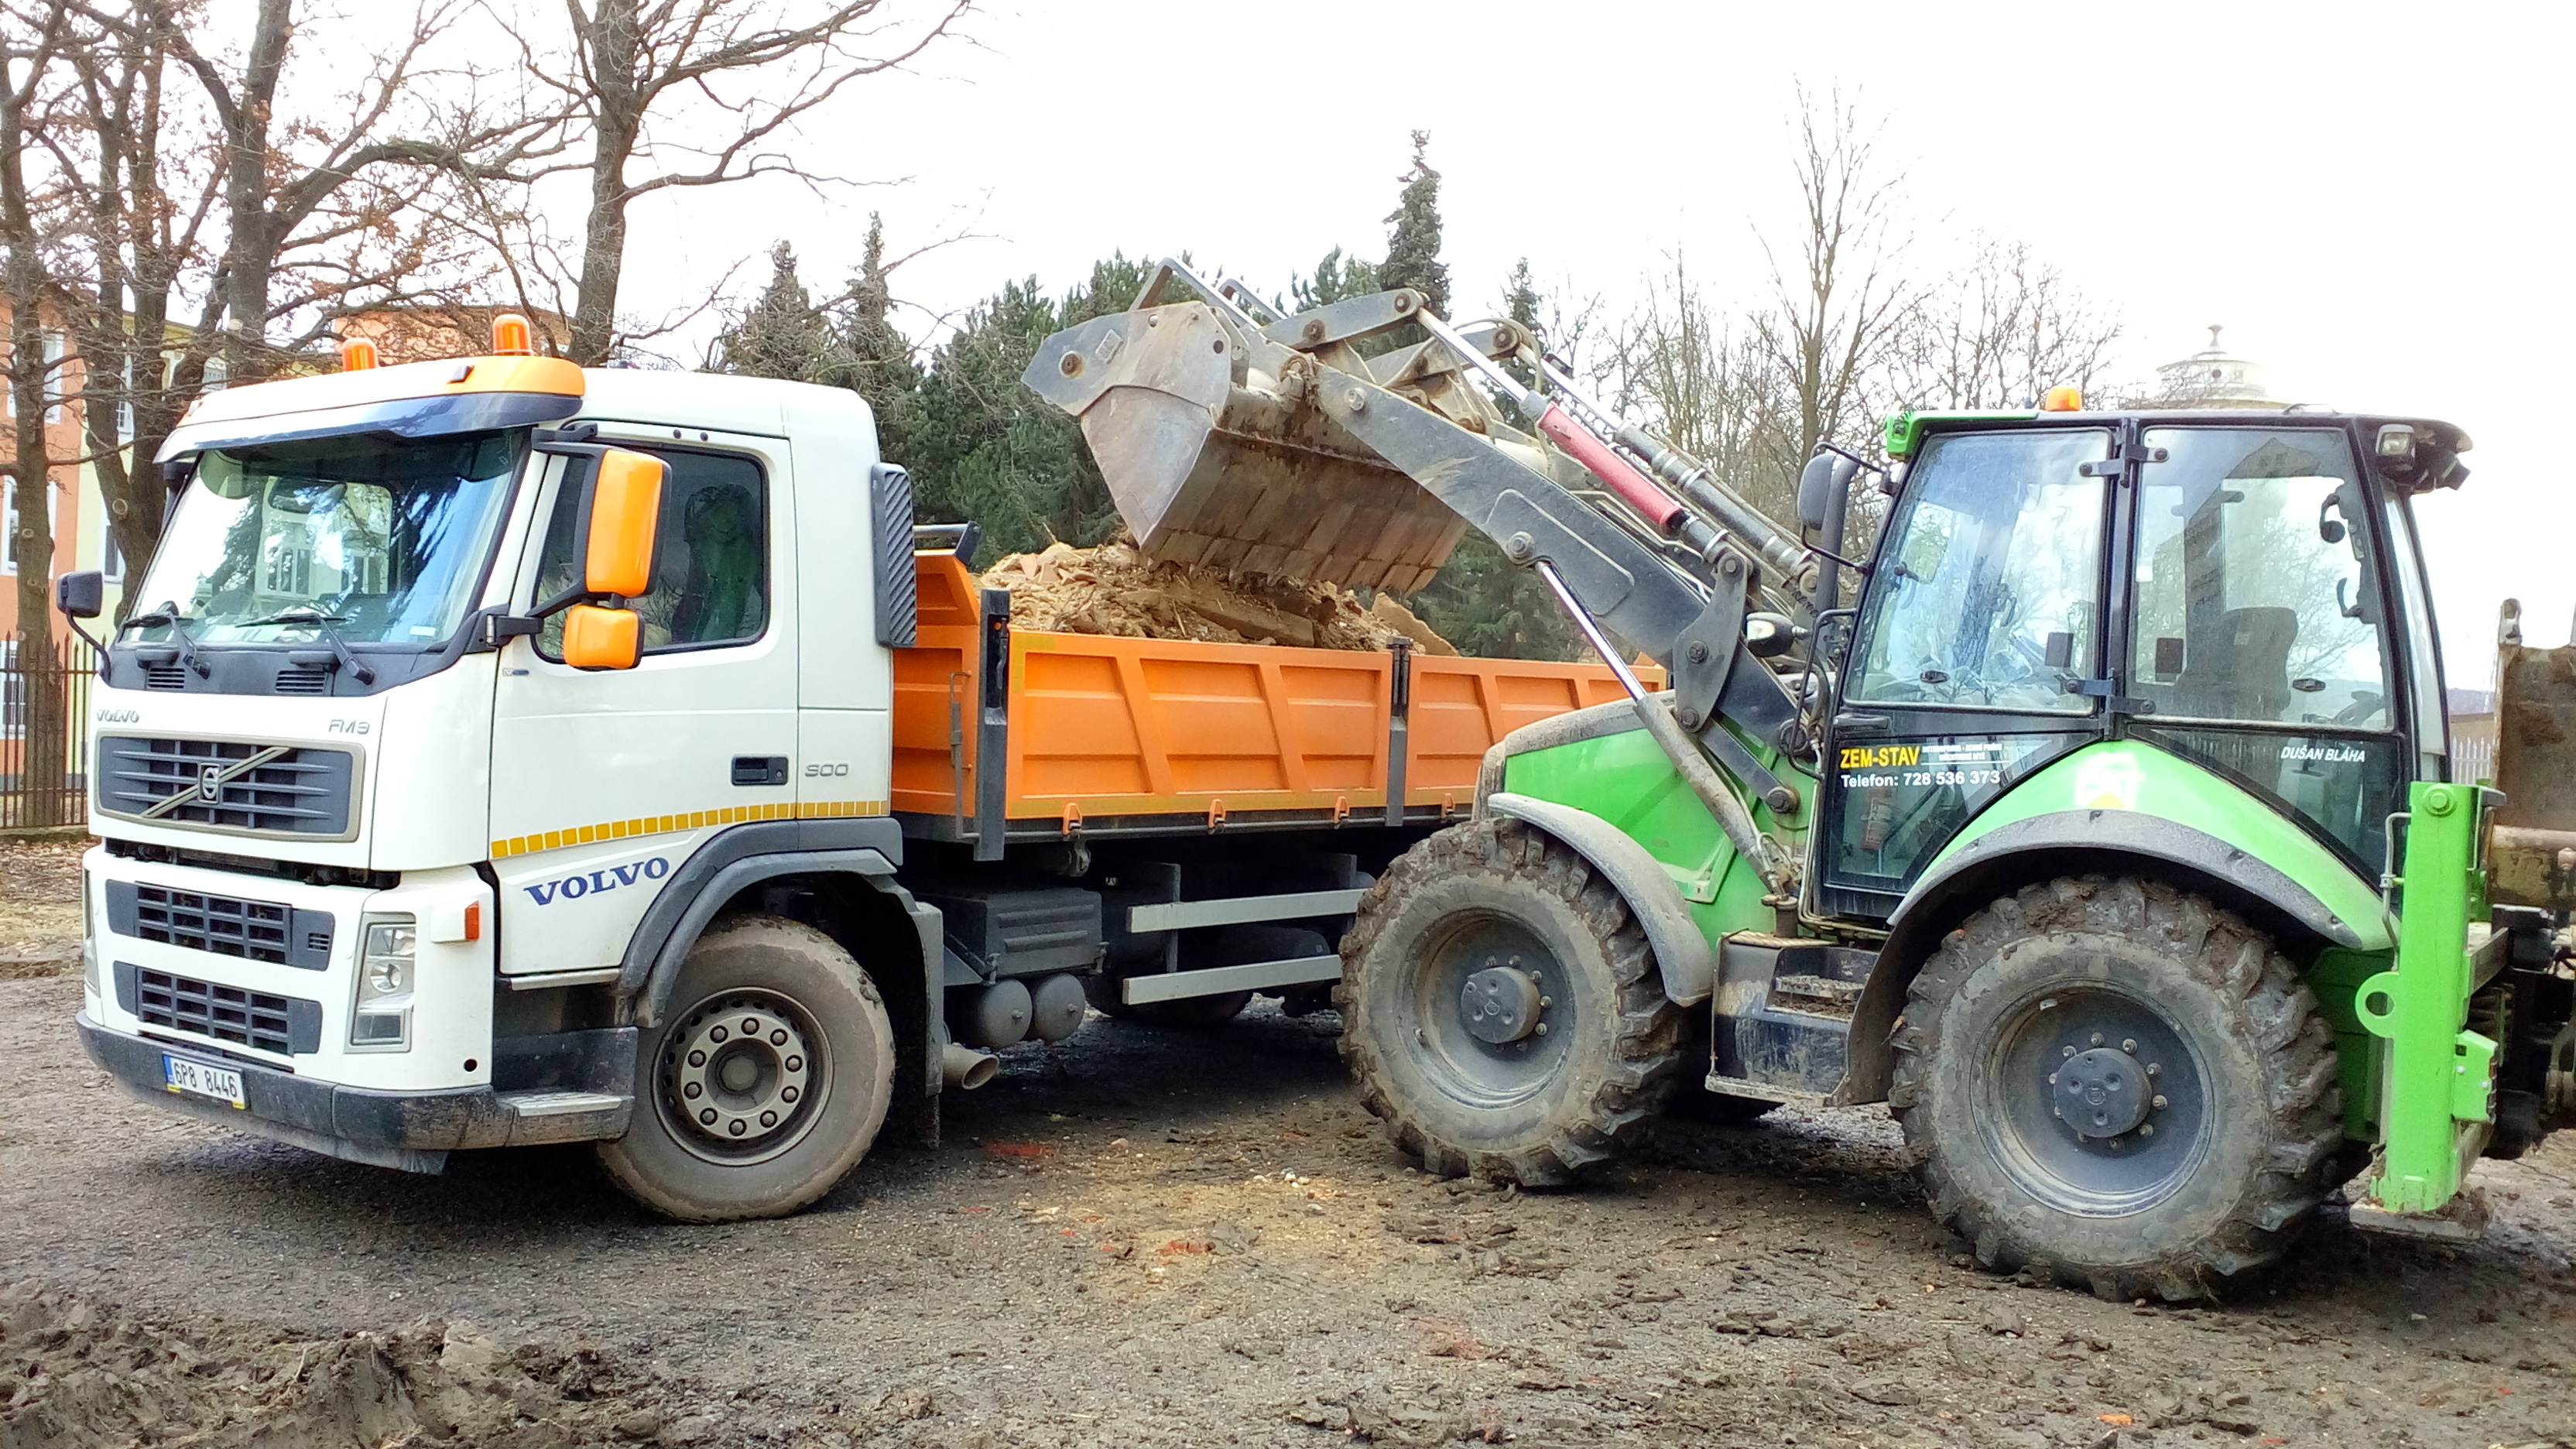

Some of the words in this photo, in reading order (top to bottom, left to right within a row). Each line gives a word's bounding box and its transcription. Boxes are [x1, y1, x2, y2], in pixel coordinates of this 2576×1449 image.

[1840, 746, 1920, 769] ZEM-STAV
[2280, 744, 2324, 760] DUŠAN
[2324, 746, 2365, 762] BLÁHA
[1840, 774, 1899, 788] Telefon:
[1903, 772, 1931, 786] 728
[1936, 771, 1965, 785] 536
[1969, 770, 2001, 784] 373
[523, 857, 670, 906] VOLVO
[173, 1062, 197, 1088] 6P8
[204, 1070, 238, 1098] 8446
